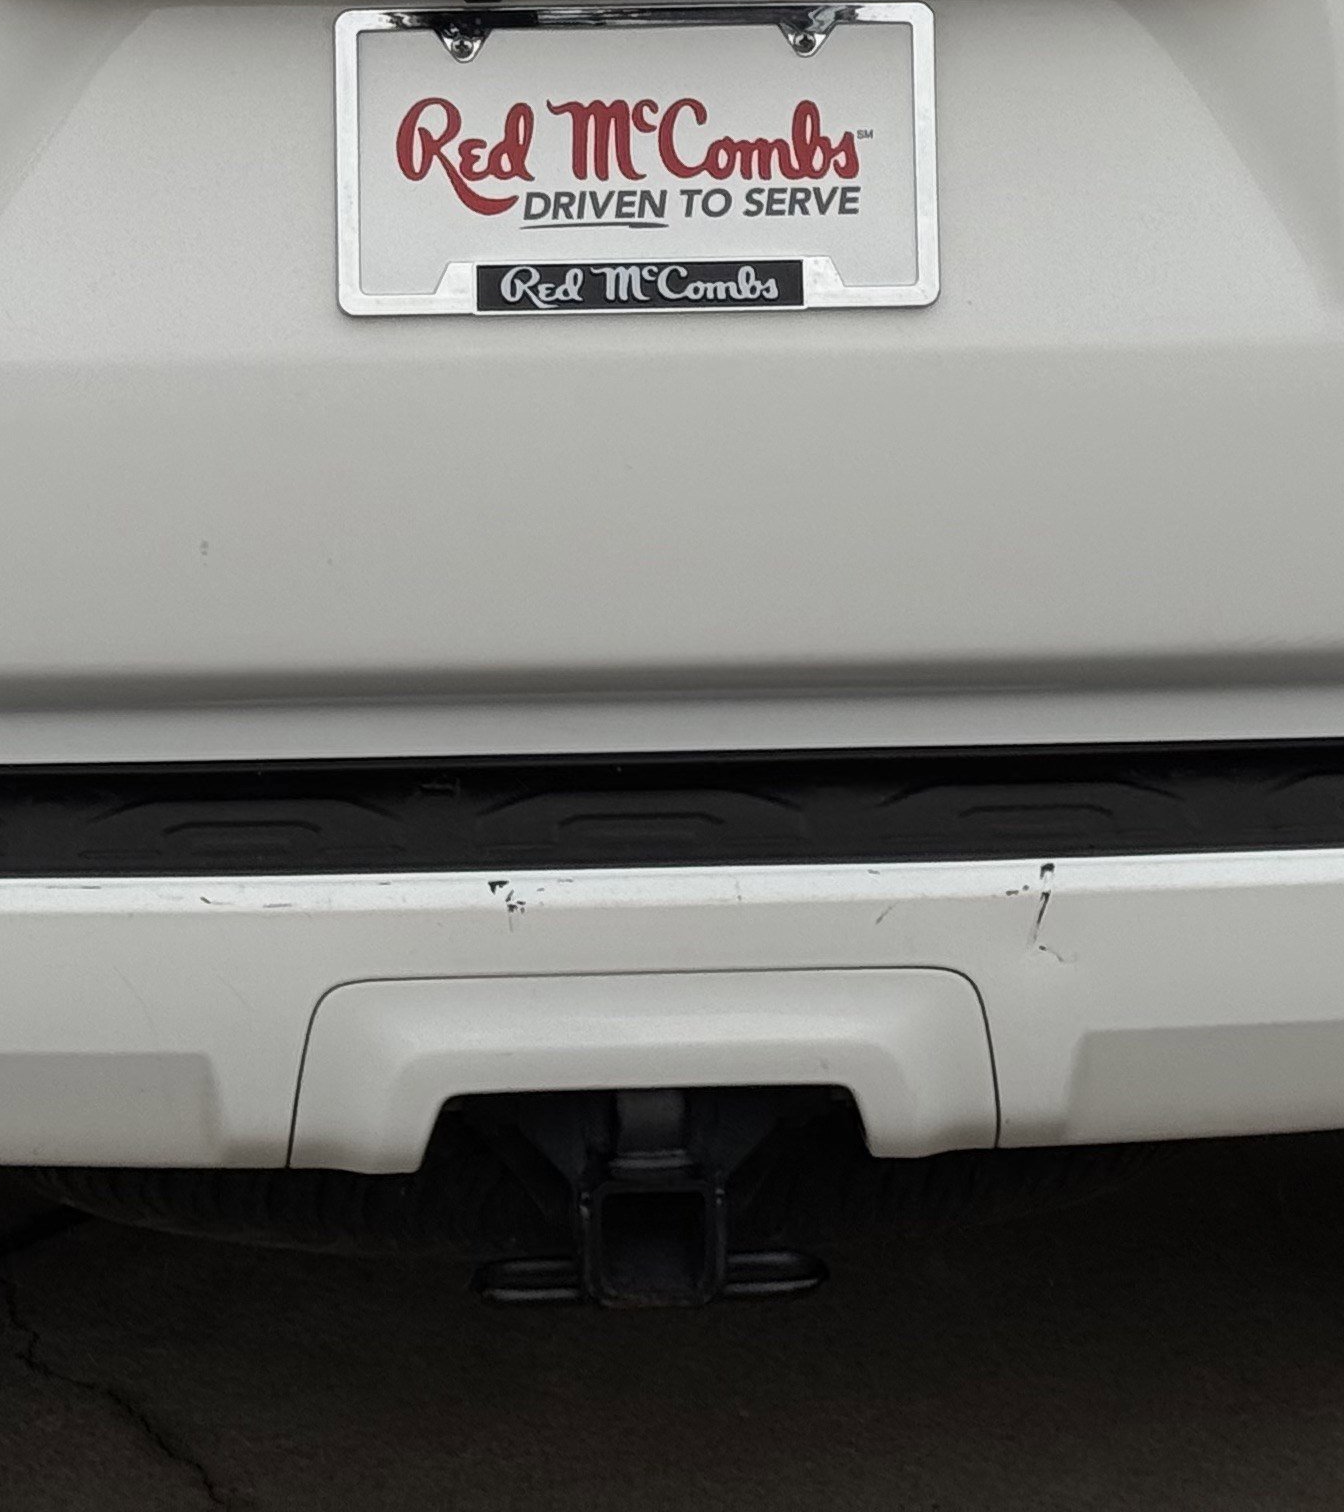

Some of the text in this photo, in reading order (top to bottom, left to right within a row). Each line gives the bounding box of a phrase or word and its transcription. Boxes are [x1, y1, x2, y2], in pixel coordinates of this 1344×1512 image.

[396, 97, 535, 215] Red
[546, 97, 860, 181] McCombs
[522, 186, 860, 222] DRIVEN TO SERVE
[500, 265, 779, 309] Red McCombs
